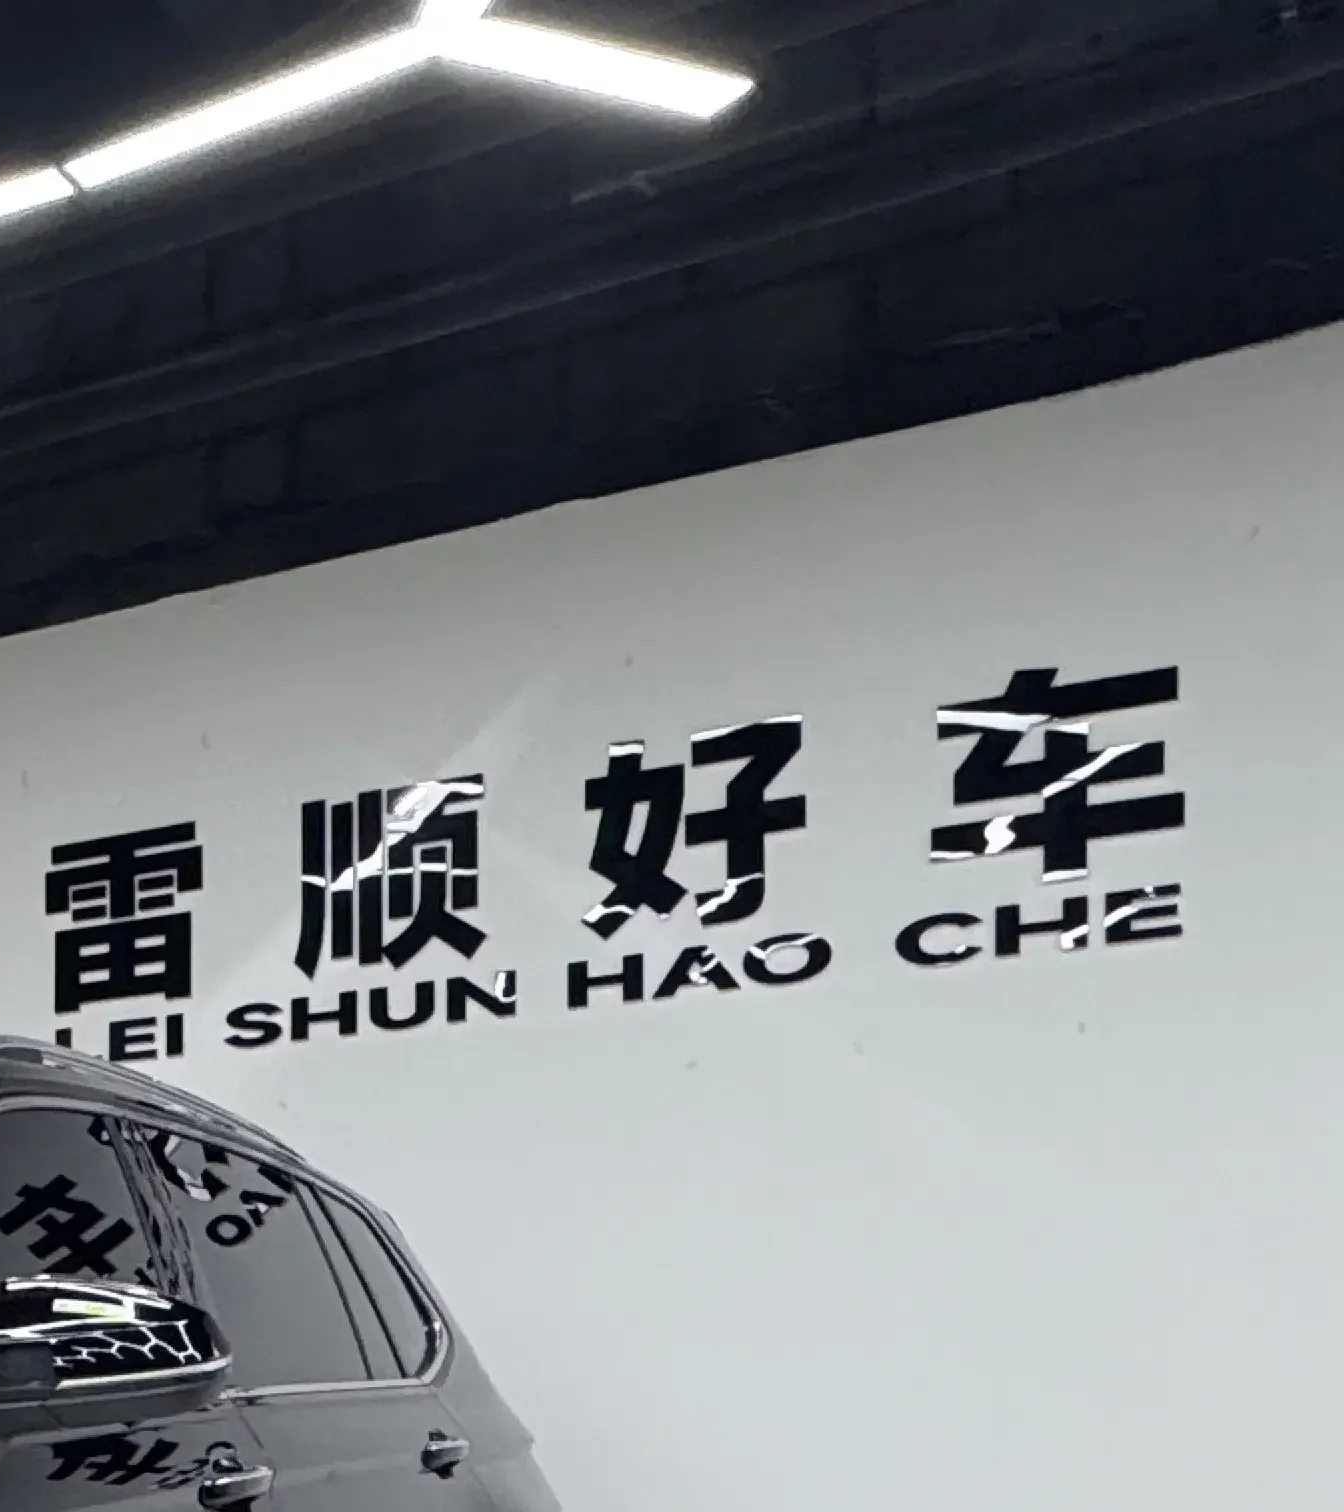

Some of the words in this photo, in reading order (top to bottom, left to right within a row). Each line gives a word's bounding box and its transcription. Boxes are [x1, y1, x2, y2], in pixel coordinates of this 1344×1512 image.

[44, 665, 1186, 1014] 雷顺好车
[223, 969, 518, 1049] SHUN
[566, 932, 833, 1009] HAO
[895, 883, 1184, 966] CHE
